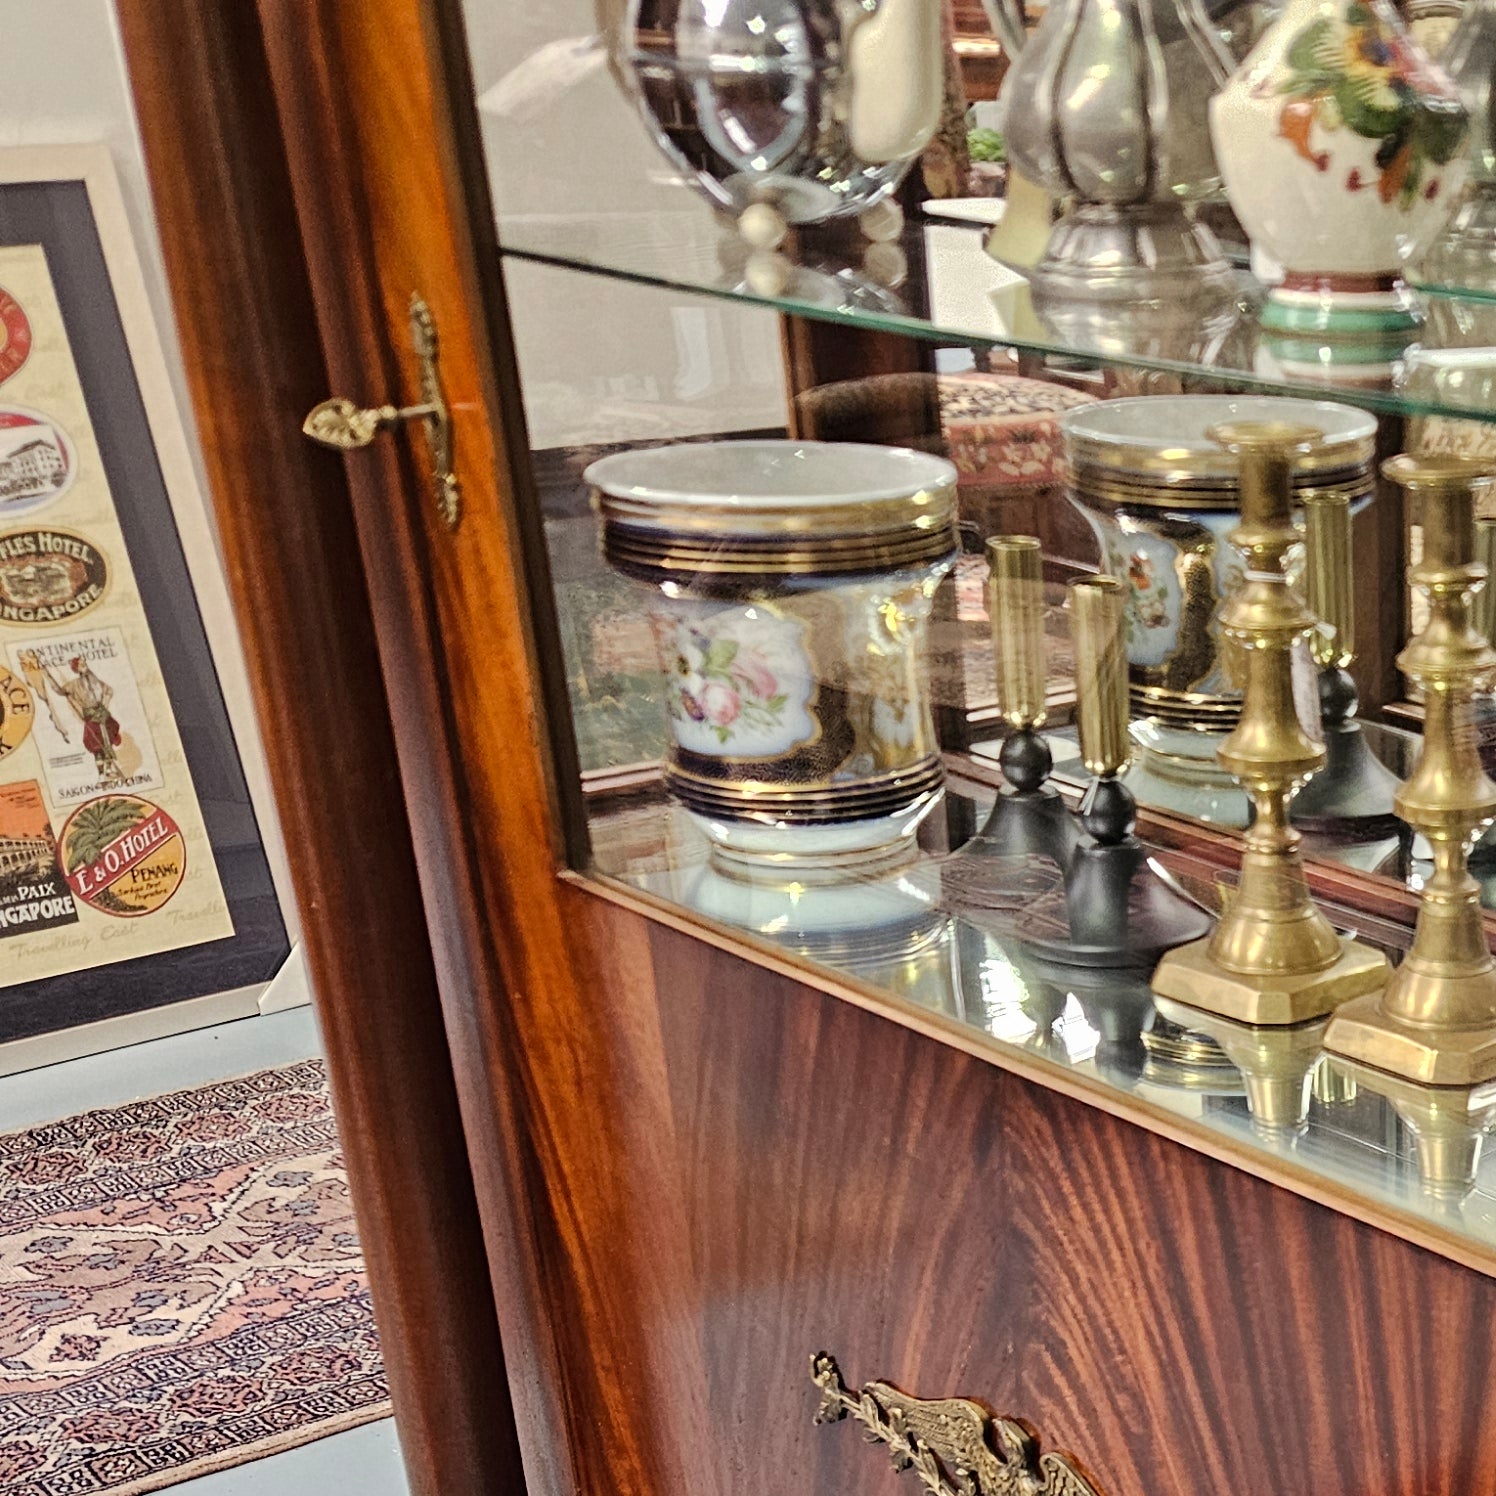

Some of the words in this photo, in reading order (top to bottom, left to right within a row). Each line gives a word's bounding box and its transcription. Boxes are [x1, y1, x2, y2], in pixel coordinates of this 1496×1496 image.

[38, 532, 94, 565] HOTEL
[17, 637, 115, 661] CONTINENTAL
[75, 869, 94, 895] E
[93, 866, 107, 882] &
[130, 863, 179, 884] PENANG
[17, 882, 56, 900] PAIX
